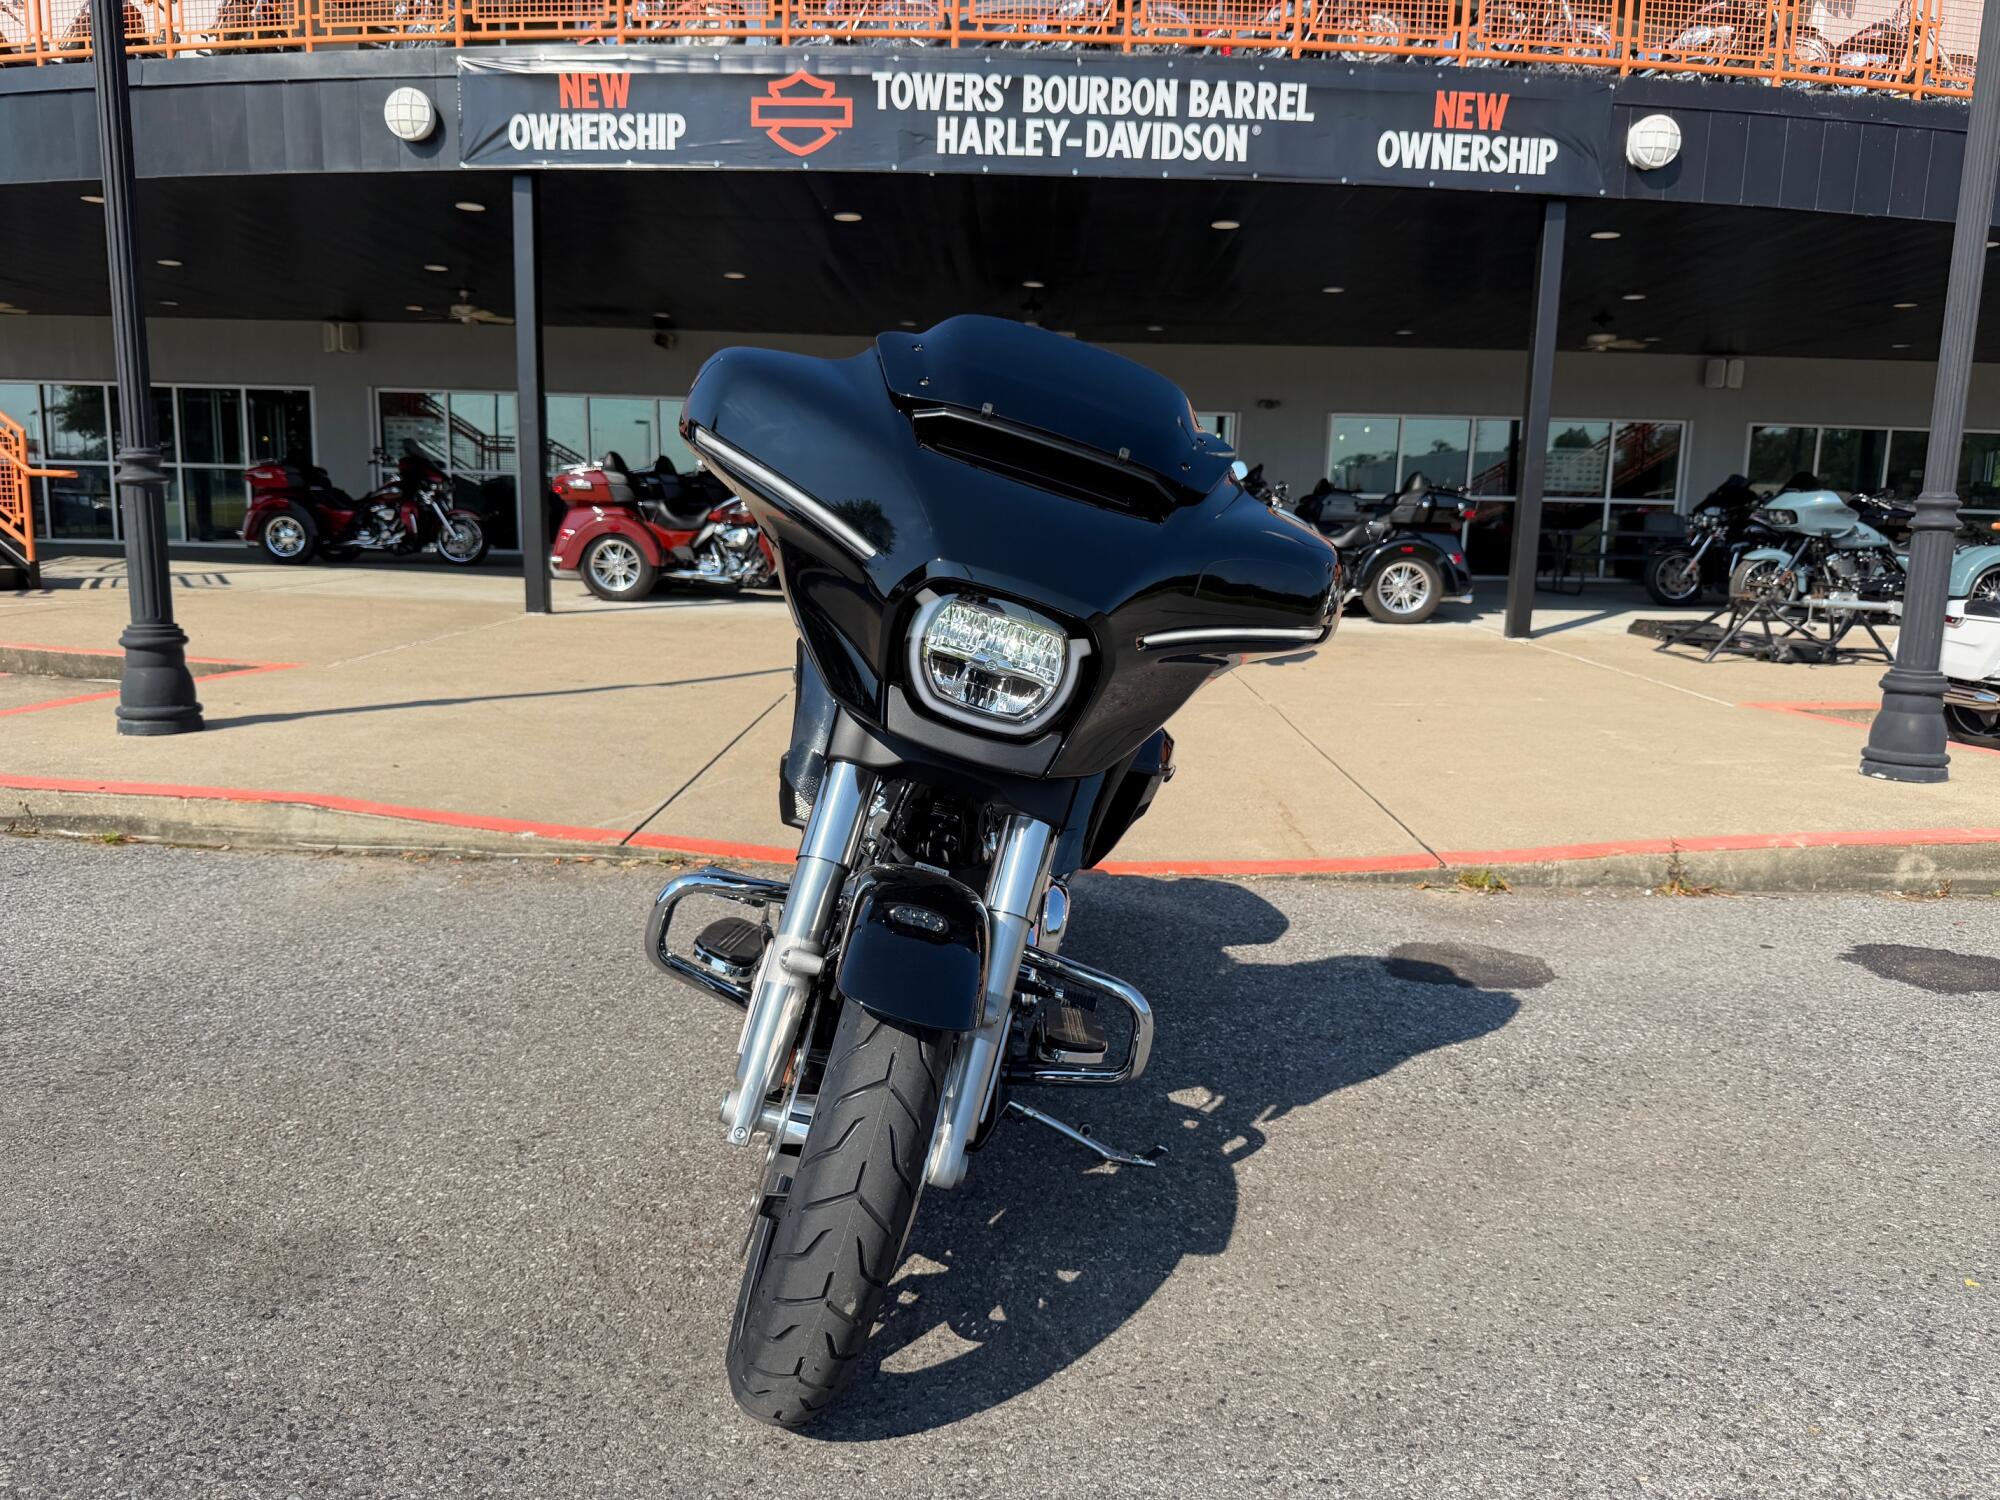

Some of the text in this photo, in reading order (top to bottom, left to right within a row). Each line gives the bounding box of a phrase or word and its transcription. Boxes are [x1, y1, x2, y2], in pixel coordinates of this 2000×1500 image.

[559, 73, 630, 109] NEW
[871, 71, 1315, 122] TOWERS' BOURBON BARREL
[1434, 91, 1510, 131] NEW
[508, 112, 687, 151] OWNERSHIP
[1377, 130, 1559, 175] OWNERSHIP
